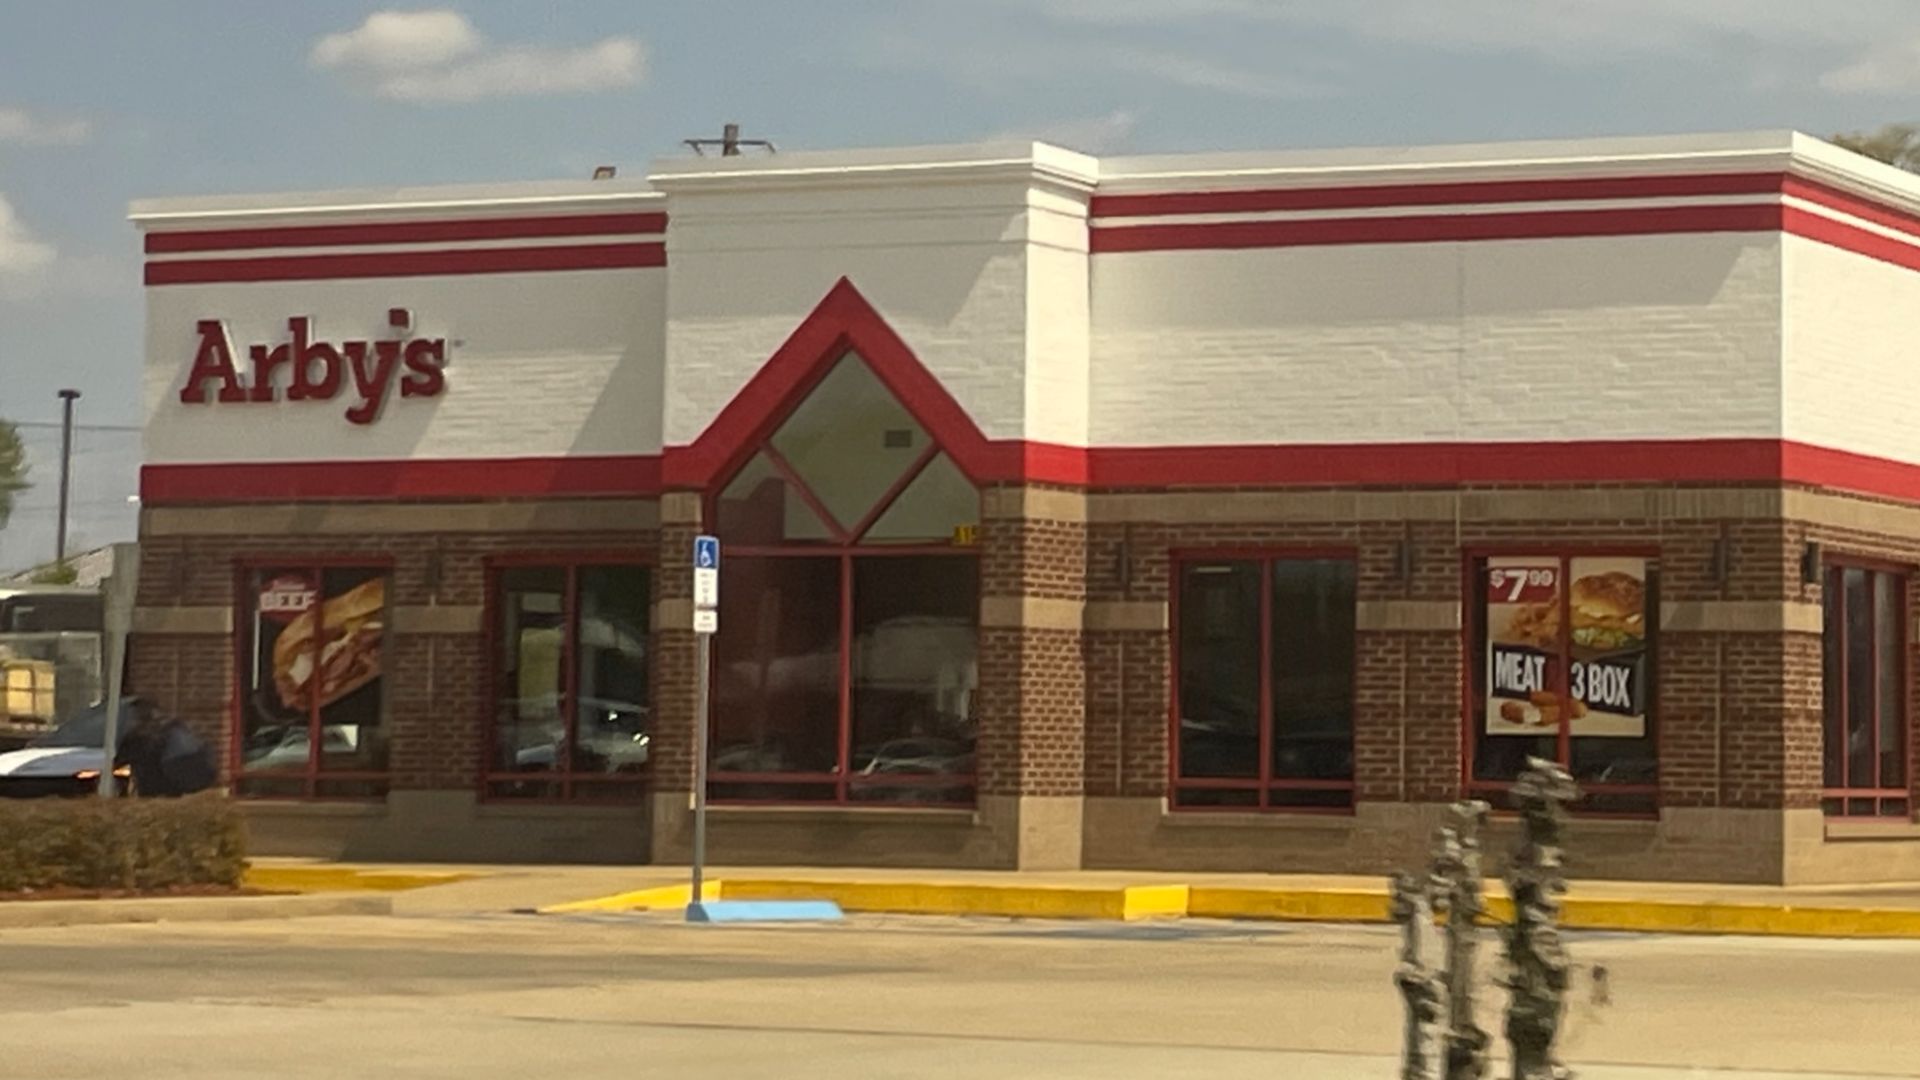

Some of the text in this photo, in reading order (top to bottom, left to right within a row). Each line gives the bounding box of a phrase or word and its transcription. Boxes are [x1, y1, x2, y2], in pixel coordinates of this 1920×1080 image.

[180, 308, 446, 424] Arby's
[1495, 651, 1631, 708] MEAT 3 BOX
